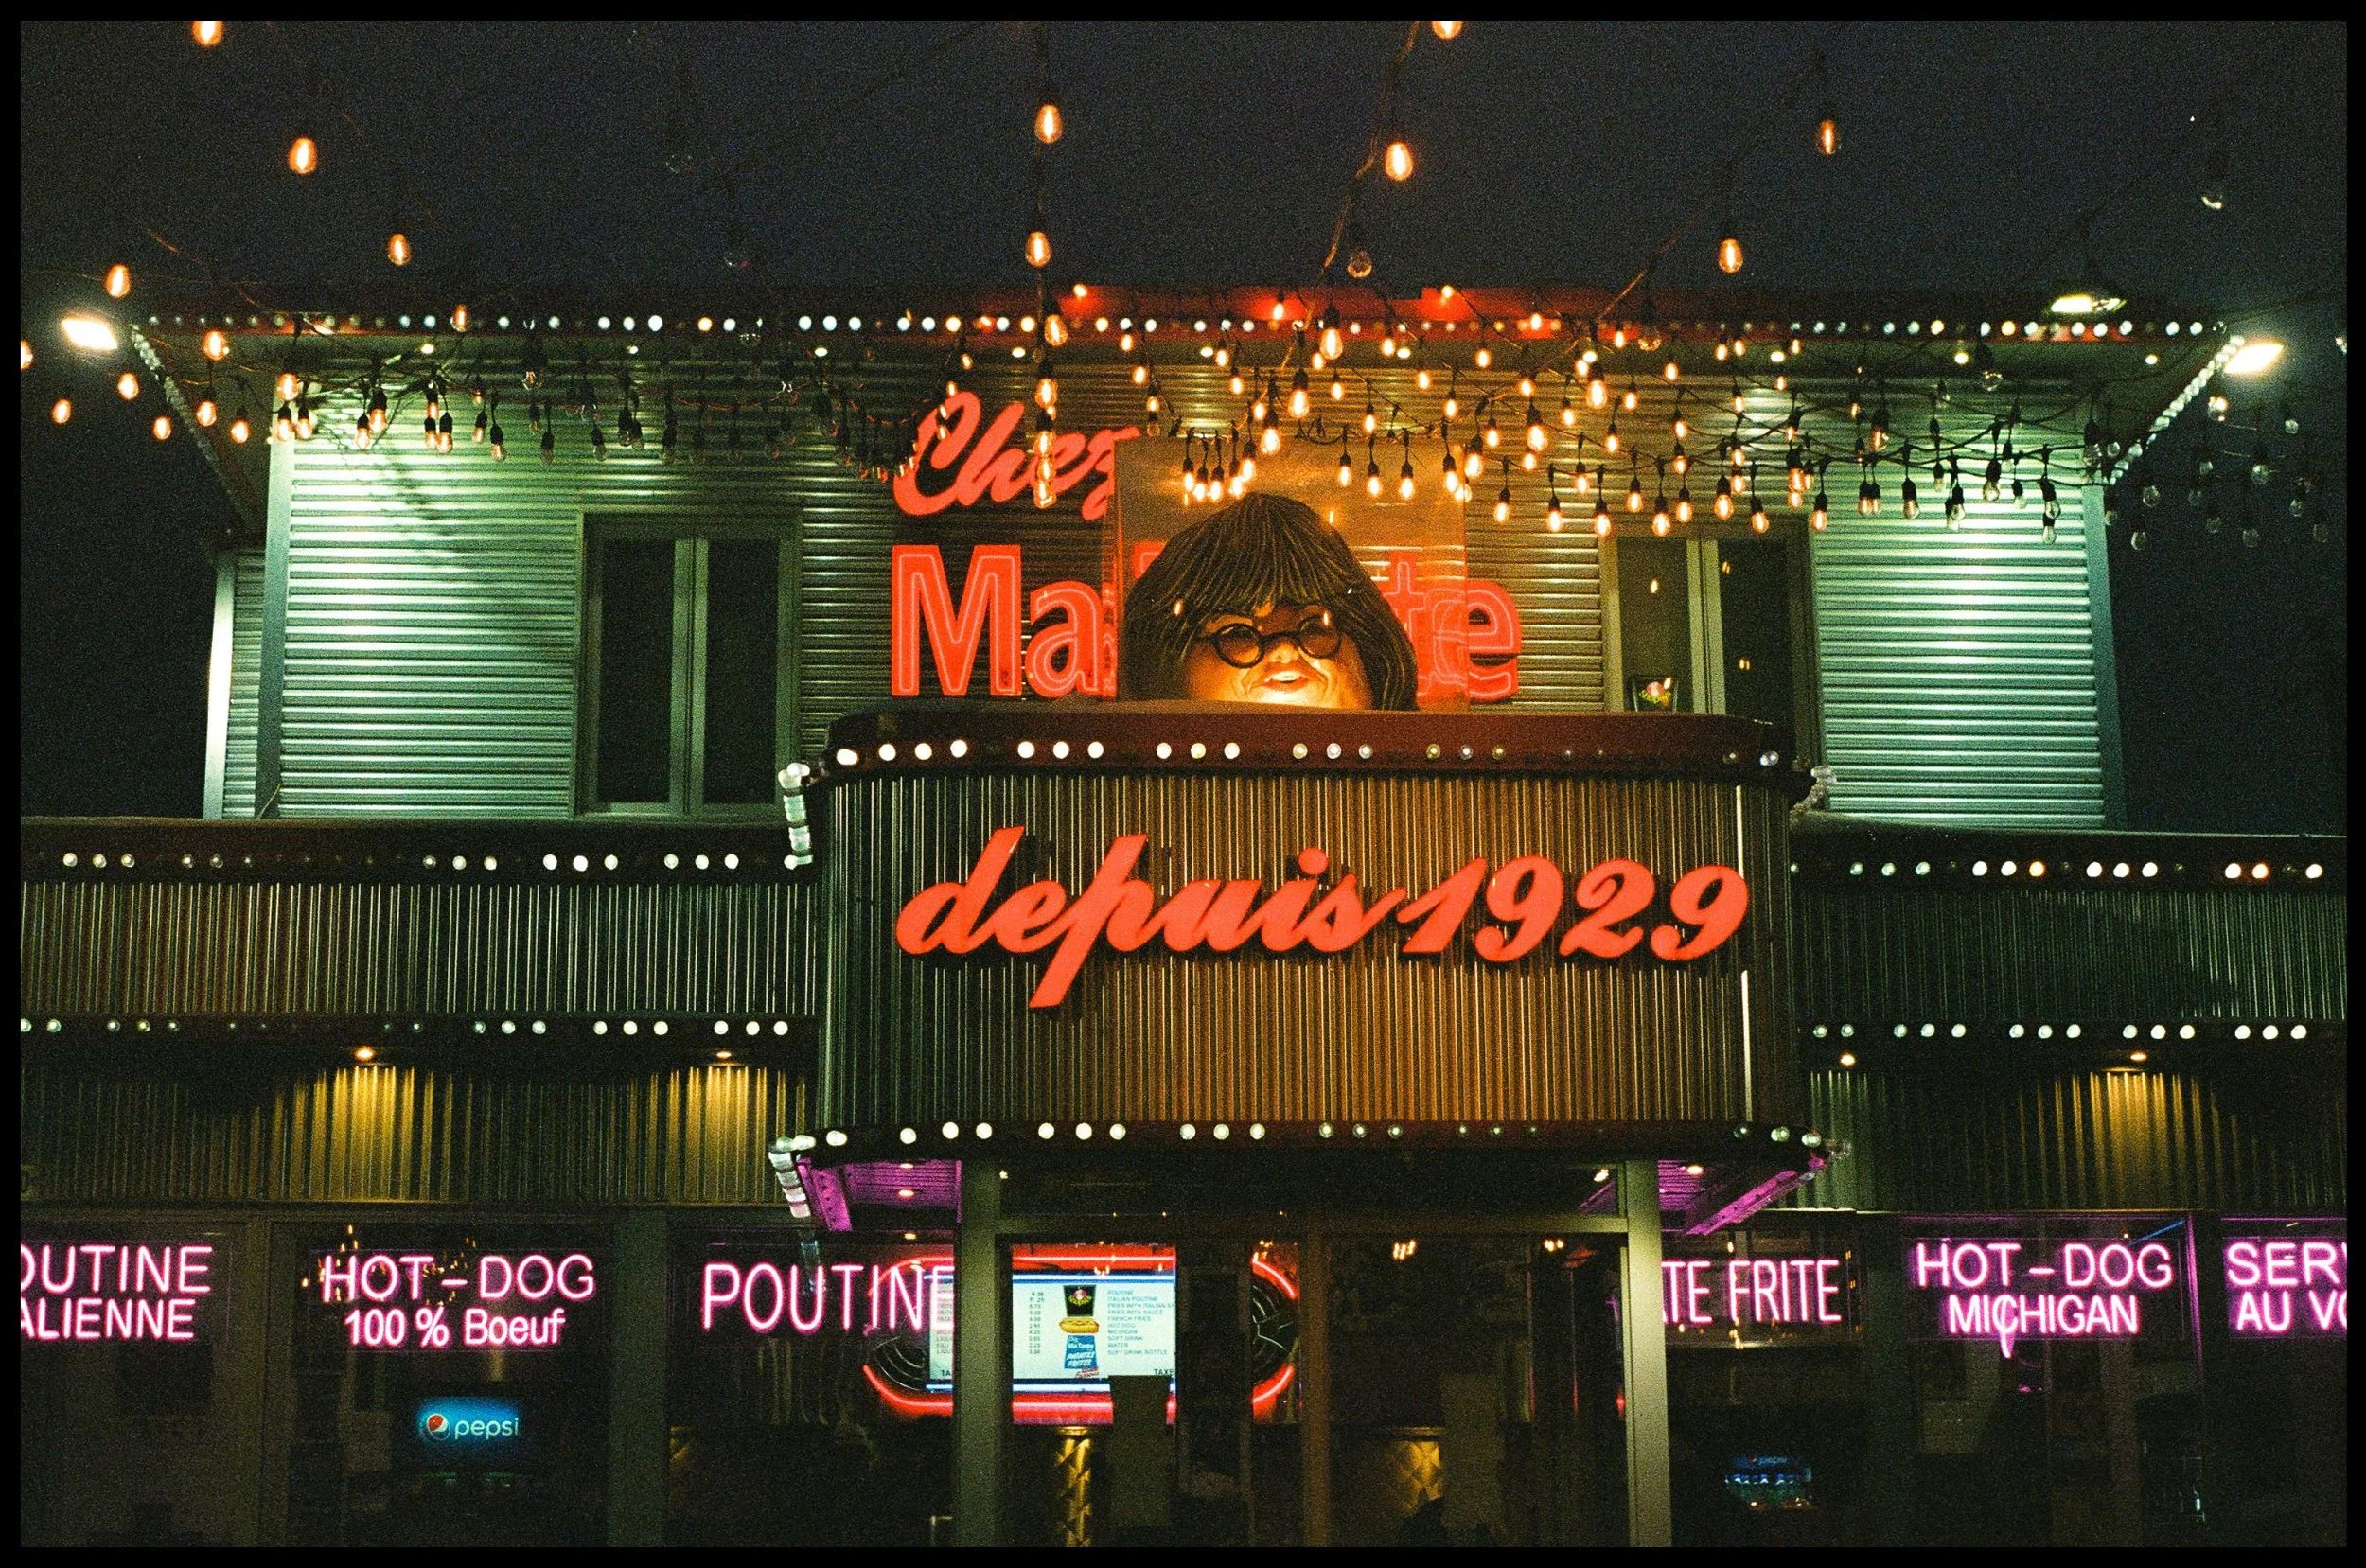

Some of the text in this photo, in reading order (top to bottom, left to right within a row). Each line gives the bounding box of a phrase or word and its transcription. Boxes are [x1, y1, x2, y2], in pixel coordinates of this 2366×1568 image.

[892, 391, 1141, 521] Chez
[891, 544, 1117, 698] Ma
[895, 826, 1749, 1009] depuis 1929
[2227, 1242, 2347, 1286] SER
[1662, 1260, 1842, 1323] TE FRITE
[2236, 1290, 2347, 1332] AU V
[345, 1306, 566, 1348] 100 % Boeuf
[1948, 1294, 2138, 1335] MICHIGAN
[454, 1418, 519, 1439] pepsi
